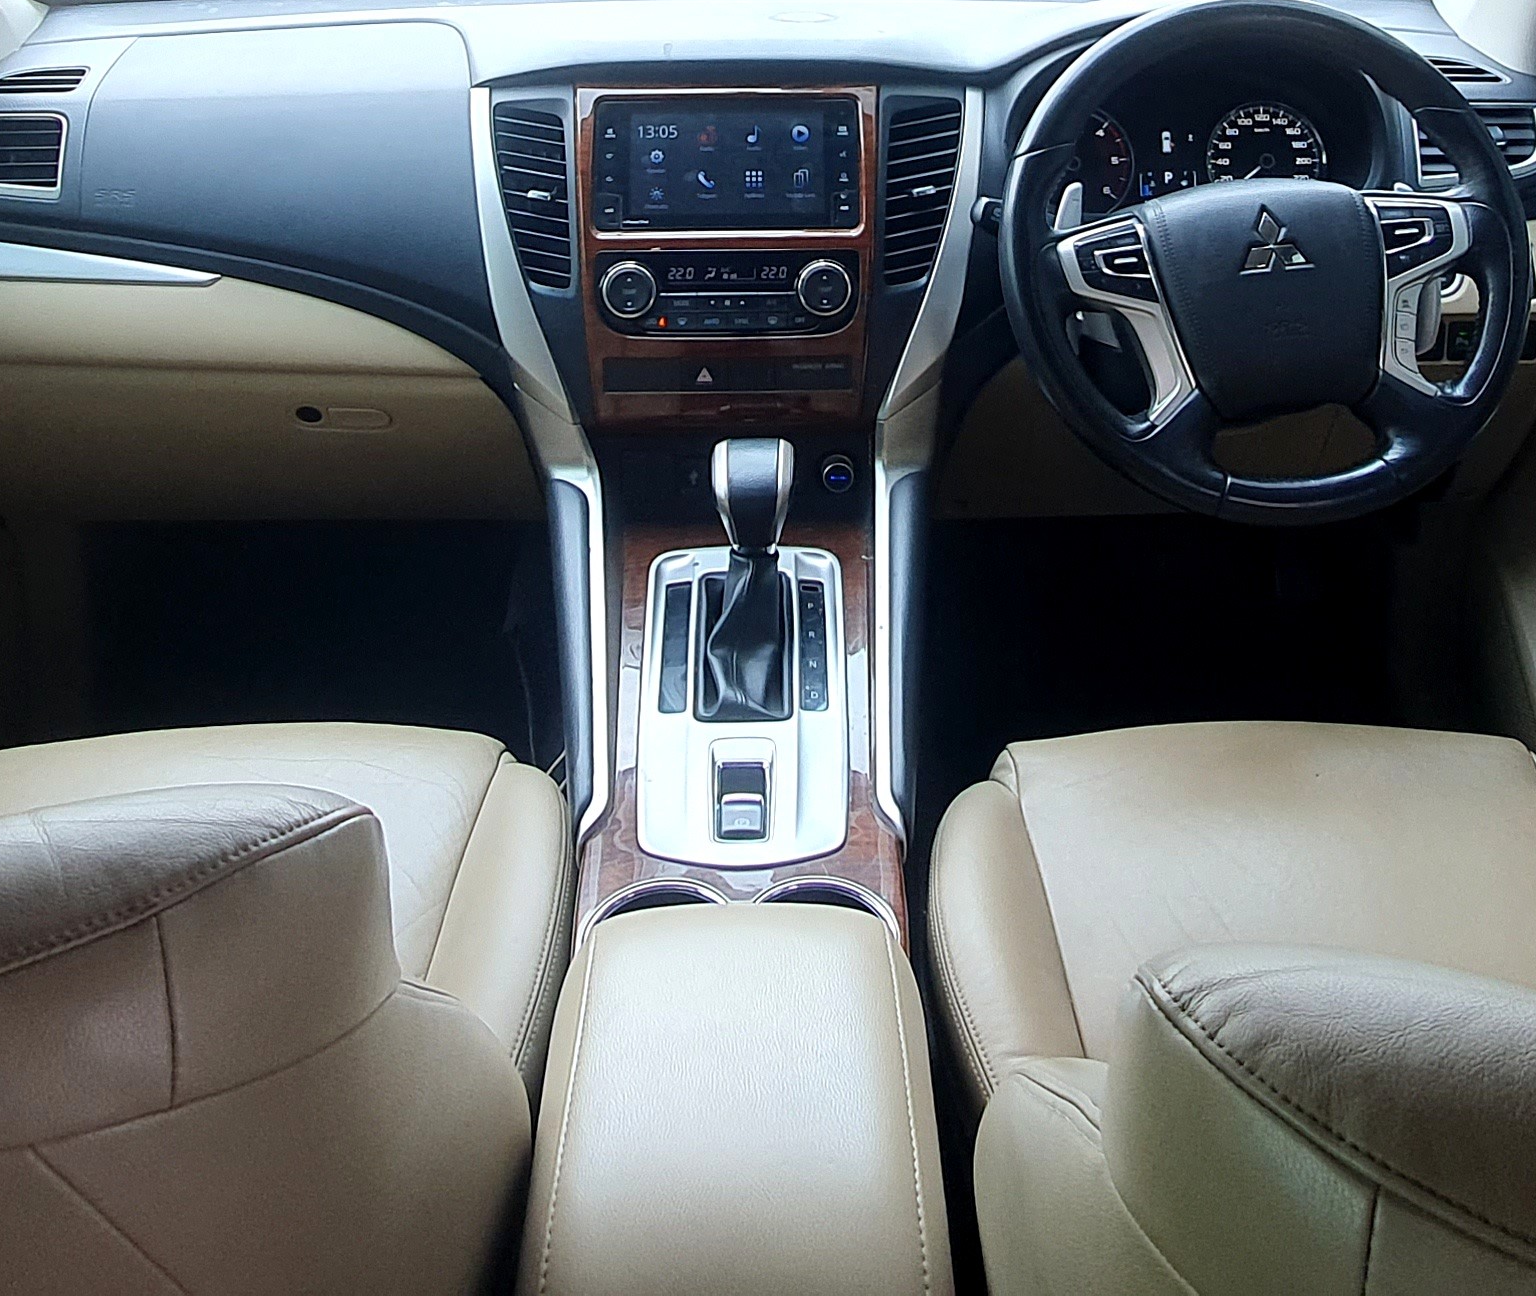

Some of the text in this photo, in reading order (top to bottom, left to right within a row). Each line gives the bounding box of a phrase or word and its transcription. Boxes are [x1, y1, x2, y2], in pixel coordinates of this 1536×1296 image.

[637, 124, 678, 139] 13:05
[1110, 156, 1119, 164] 5
[1164, 171, 1173, 184] P
[809, 660, 817, 668] N
[810, 691, 819, 699] D
